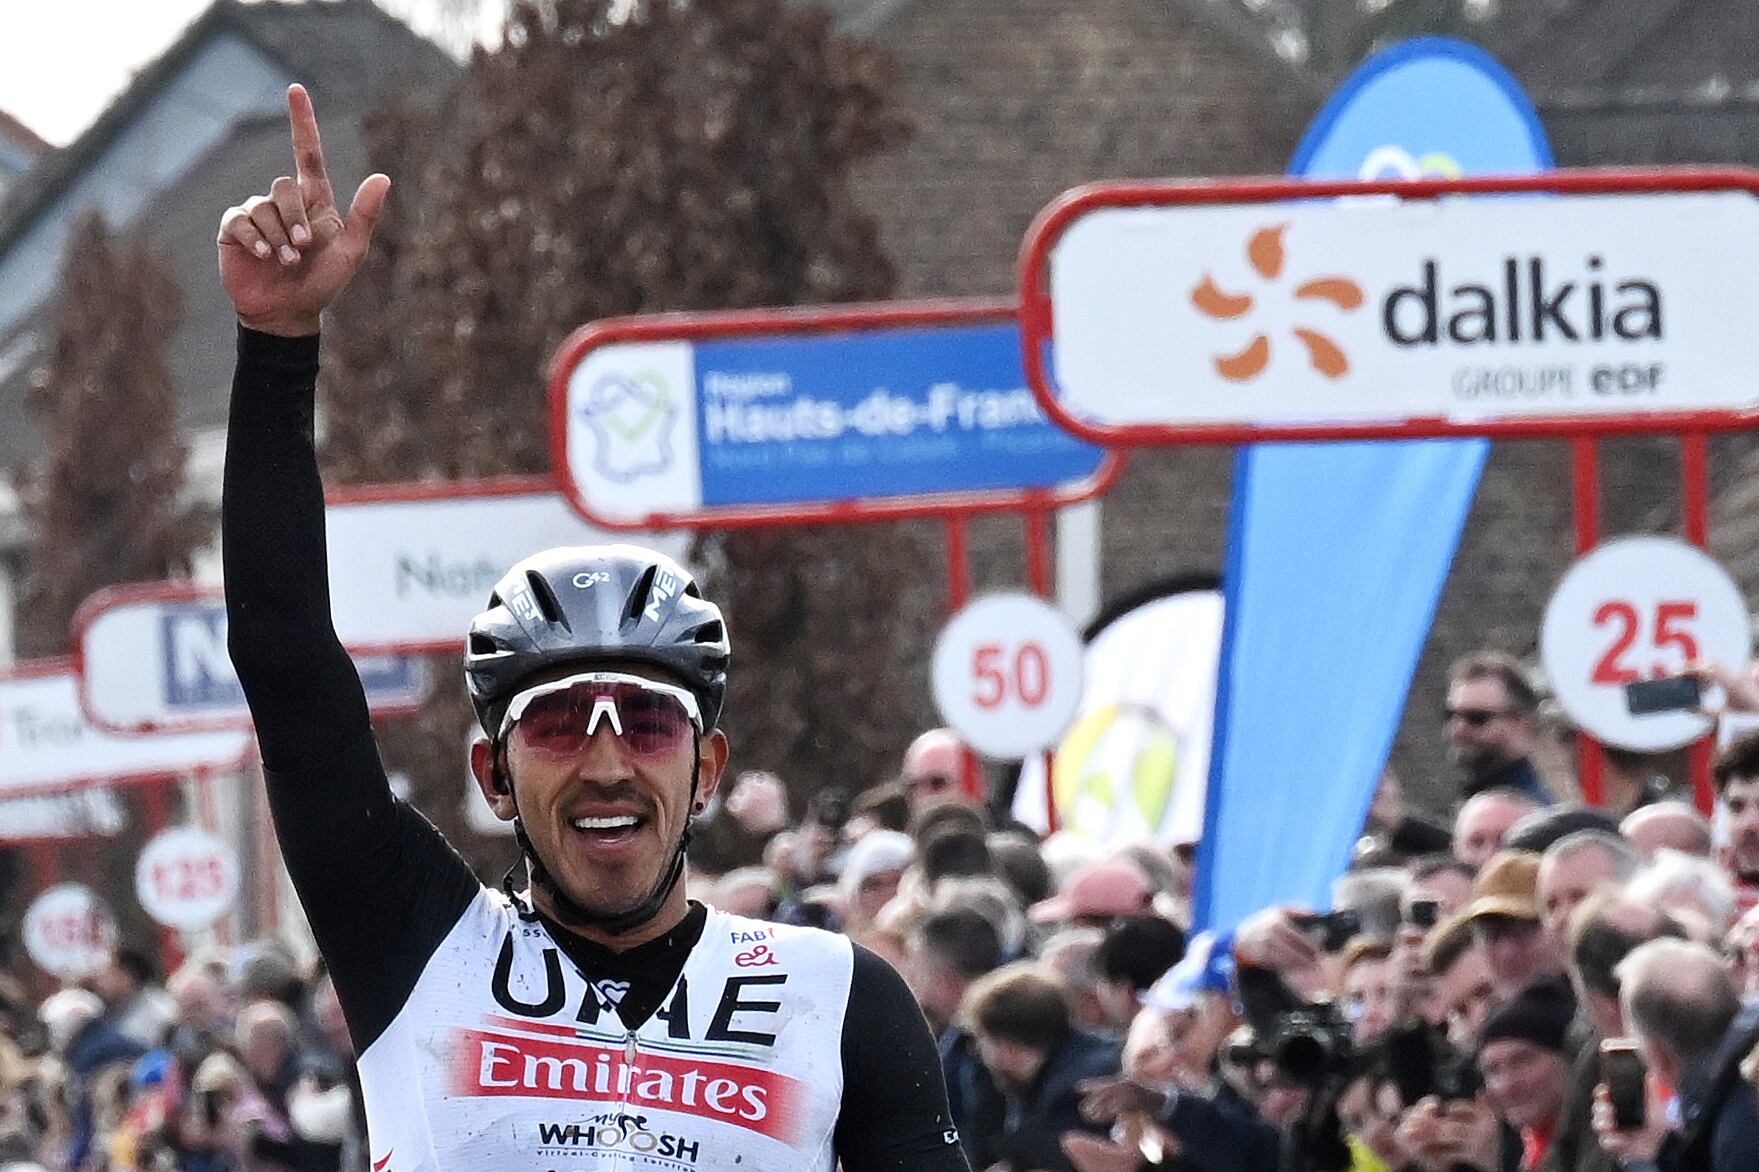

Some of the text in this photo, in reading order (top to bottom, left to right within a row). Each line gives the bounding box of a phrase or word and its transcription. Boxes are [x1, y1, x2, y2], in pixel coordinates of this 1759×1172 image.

[1382, 255, 1663, 346] dalkia
[971, 643, 1052, 710] 50
[1591, 600, 1701, 686] 25
[730, 929, 767, 945] FAB
[490, 929, 789, 1048] UAE
[479, 1039, 768, 1122] Emirates
[538, 1122, 700, 1164] WHOOSH
